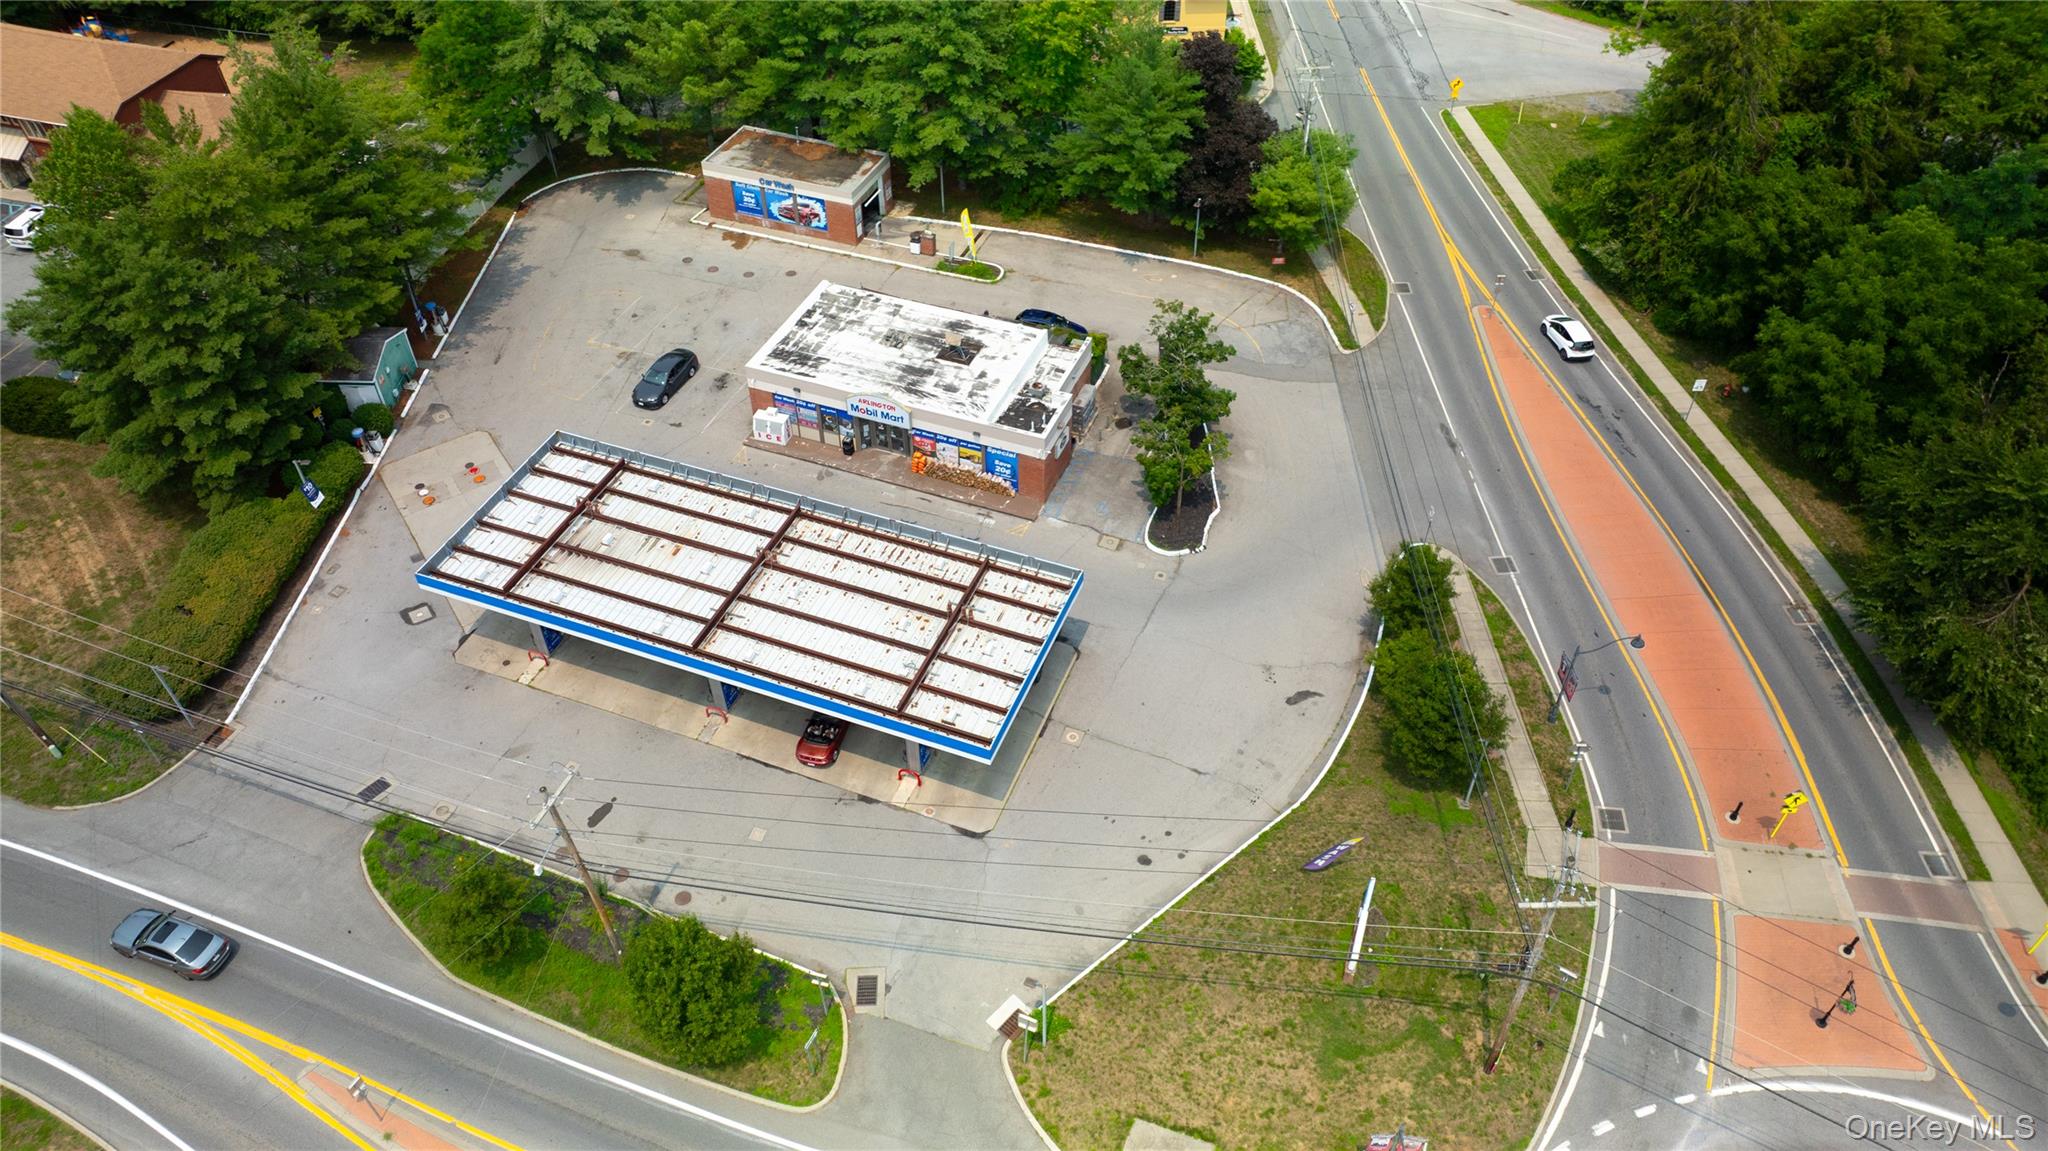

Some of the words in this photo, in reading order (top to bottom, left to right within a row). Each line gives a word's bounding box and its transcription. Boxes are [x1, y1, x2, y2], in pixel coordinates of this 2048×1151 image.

[759, 177, 772, 187] Car
[774, 179, 794, 192] Wash
[858, 398, 896, 411] ARLINGTON
[850, 403, 878, 417] Mobil
[880, 411, 904, 424] Mart
[758, 432, 782, 442] ICE
[986, 446, 1017, 458] Special
[994, 459, 1011, 468] Save
[995, 466, 1011, 475] 20¢
